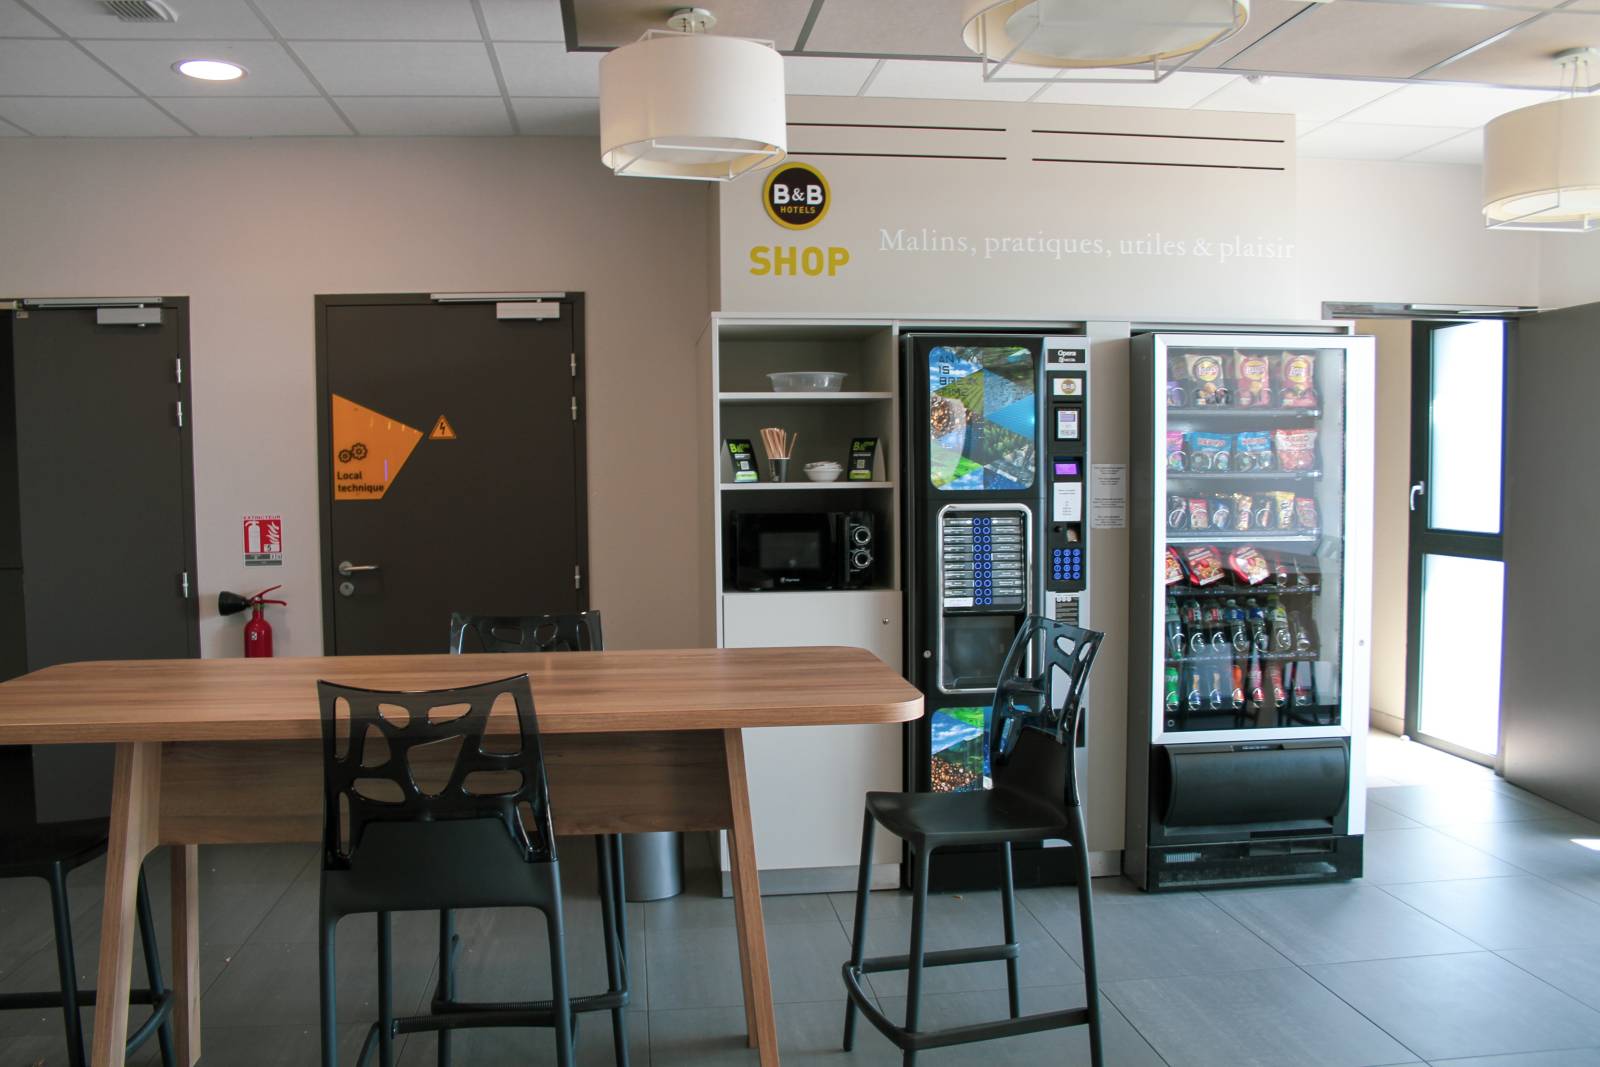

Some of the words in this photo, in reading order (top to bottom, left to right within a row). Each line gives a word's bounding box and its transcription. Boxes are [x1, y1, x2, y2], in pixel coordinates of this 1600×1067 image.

[773, 183, 823, 205] B&B
[780, 205, 816, 214] HOTELS
[879, 228, 976, 257] Malins,
[984, 231, 1112, 260] pratiques,
[1119, 232, 1185, 256] utiles
[1192, 237, 1215, 256] &
[1219, 234, 1296, 264] plaisir
[749, 245, 850, 277] SHOP
[336, 471, 363, 481] Local
[337, 483, 385, 495] technique
